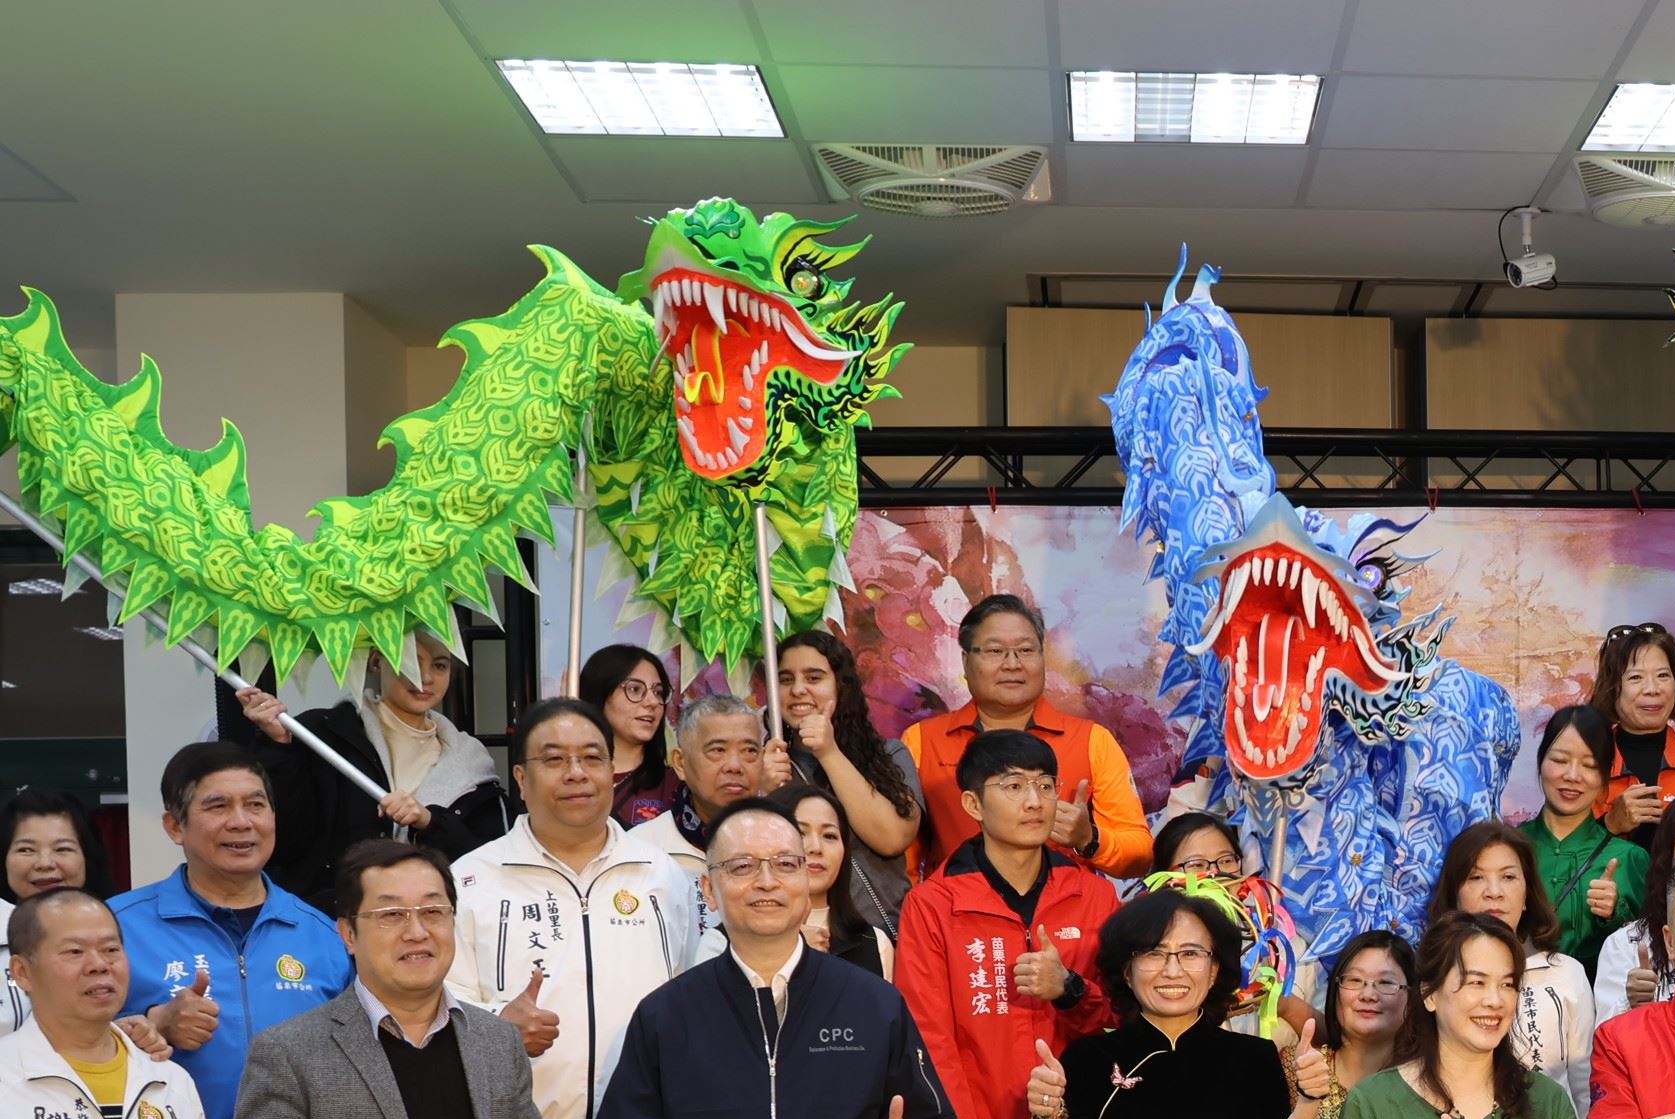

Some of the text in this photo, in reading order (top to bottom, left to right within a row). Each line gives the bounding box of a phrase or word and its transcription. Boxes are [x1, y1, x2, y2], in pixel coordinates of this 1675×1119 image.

[545, 890, 564, 941] 上苗里長
[965, 938, 993, 1016] 李建宏
[991, 937, 1009, 1014] 苗栗市民代表
[819, 1028, 854, 1042] CPC
